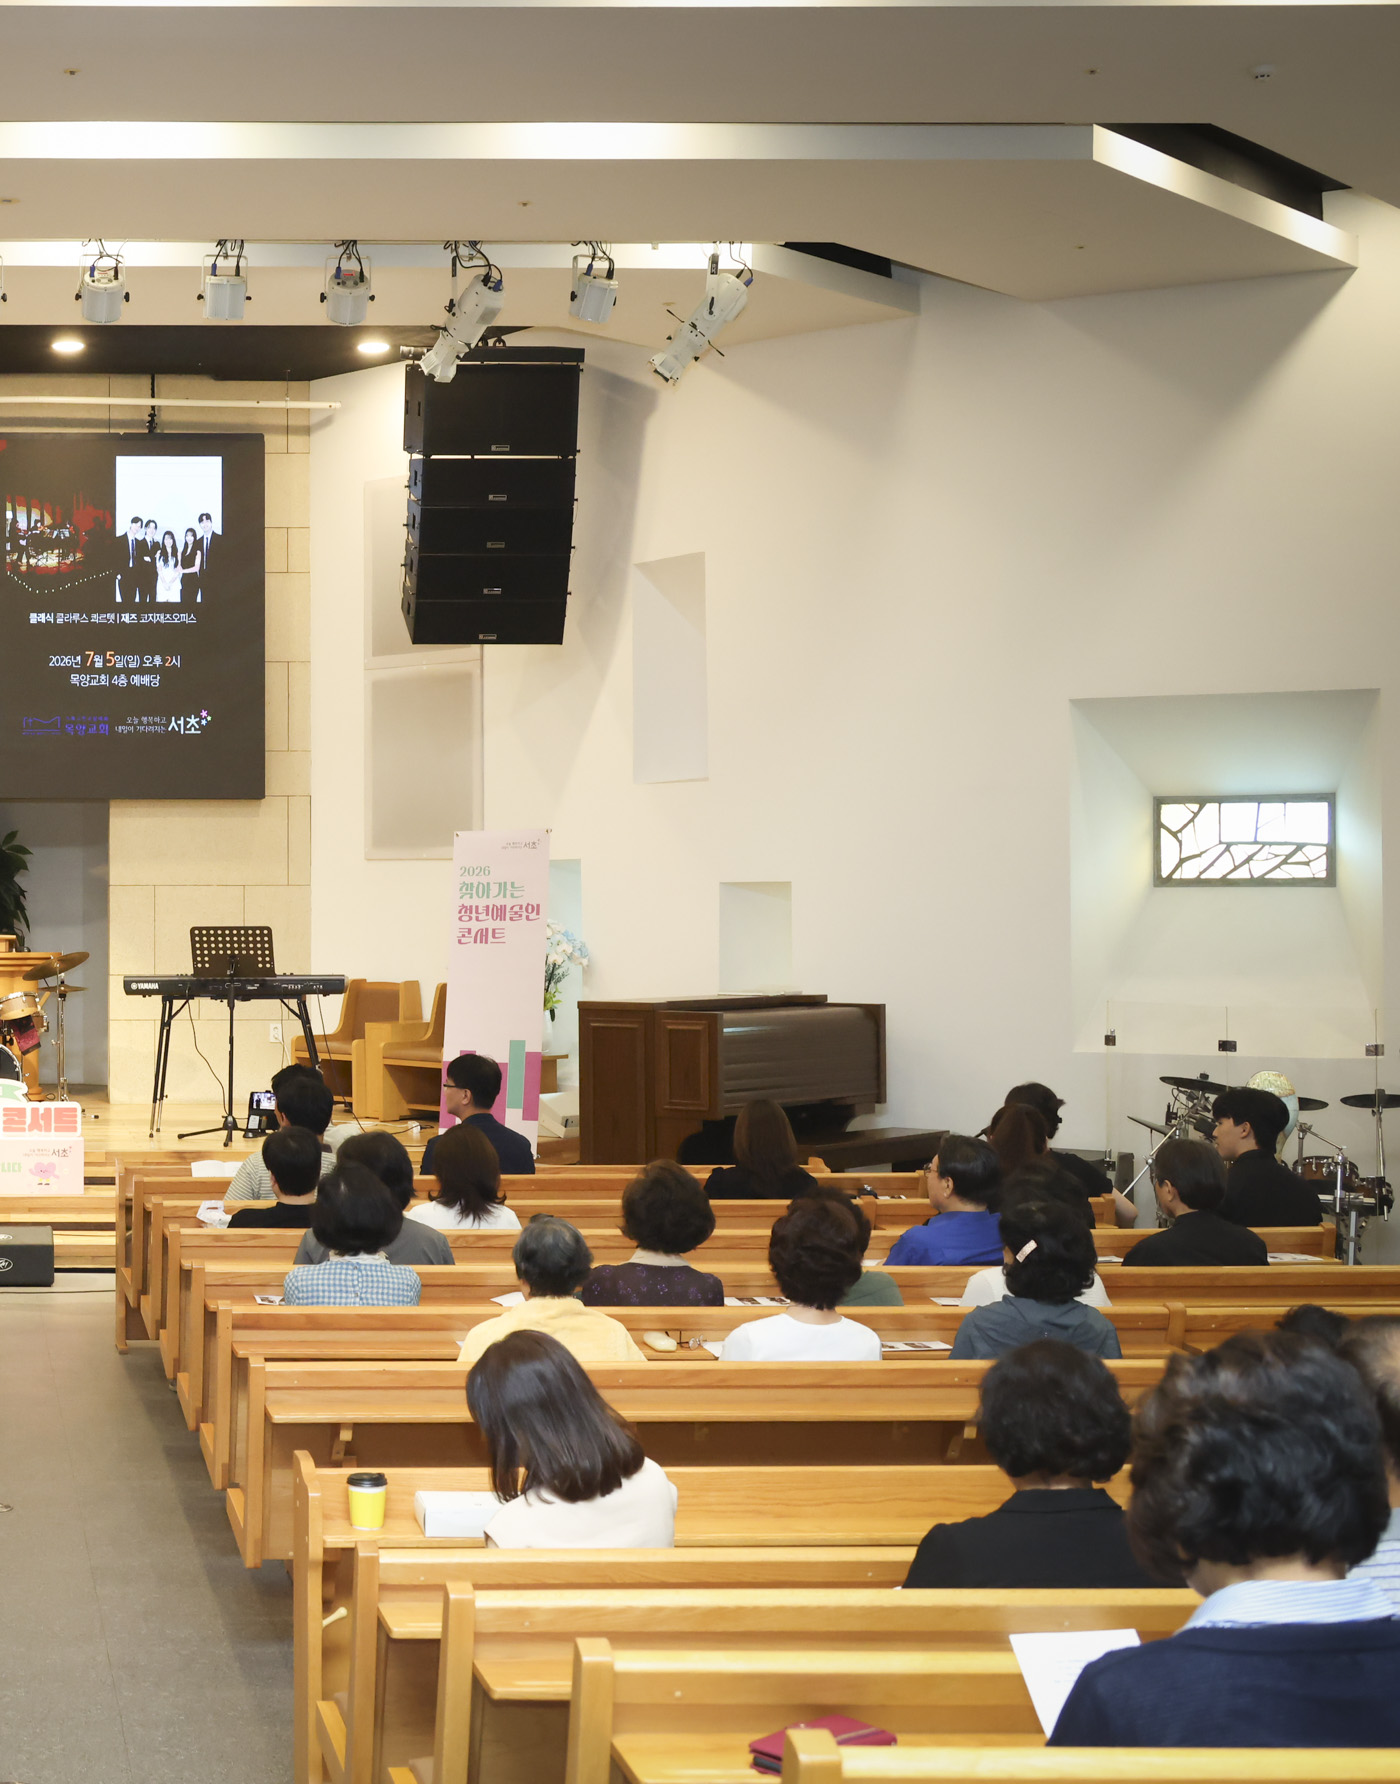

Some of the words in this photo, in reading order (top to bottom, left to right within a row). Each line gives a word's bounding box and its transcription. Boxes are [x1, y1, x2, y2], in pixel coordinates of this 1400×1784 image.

[29, 612, 54, 624] 클래식
[120, 612, 138, 624] 재즈
[139, 612, 197, 624] 코지재즈오피스
[48, 655, 81, 668] 2026년
[85, 651, 104, 668] 7월
[106, 651, 140, 668] 5일(일)
[142, 655, 163, 668] 오후
[165, 655, 181, 668] 2시
[70, 673, 109, 687] 목양교회
[111, 673, 128, 687] 4층
[130, 673, 161, 687] 예배당
[126, 716, 139, 724] 오늘
[168, 714, 201, 735] 서초
[65, 723, 109, 736] 목양교회
[523, 841, 537, 849] 서초
[459, 866, 491, 877] 2026
[458, 881, 525, 899] 찾아가는
[457, 902, 541, 922] 청년예술인
[456, 927, 506, 945] 콘서트
[137, 982, 159, 990] YAMAHA
[2, 1107, 78, 1133] 콘서트
[51, 1148, 69, 1158] 서초
